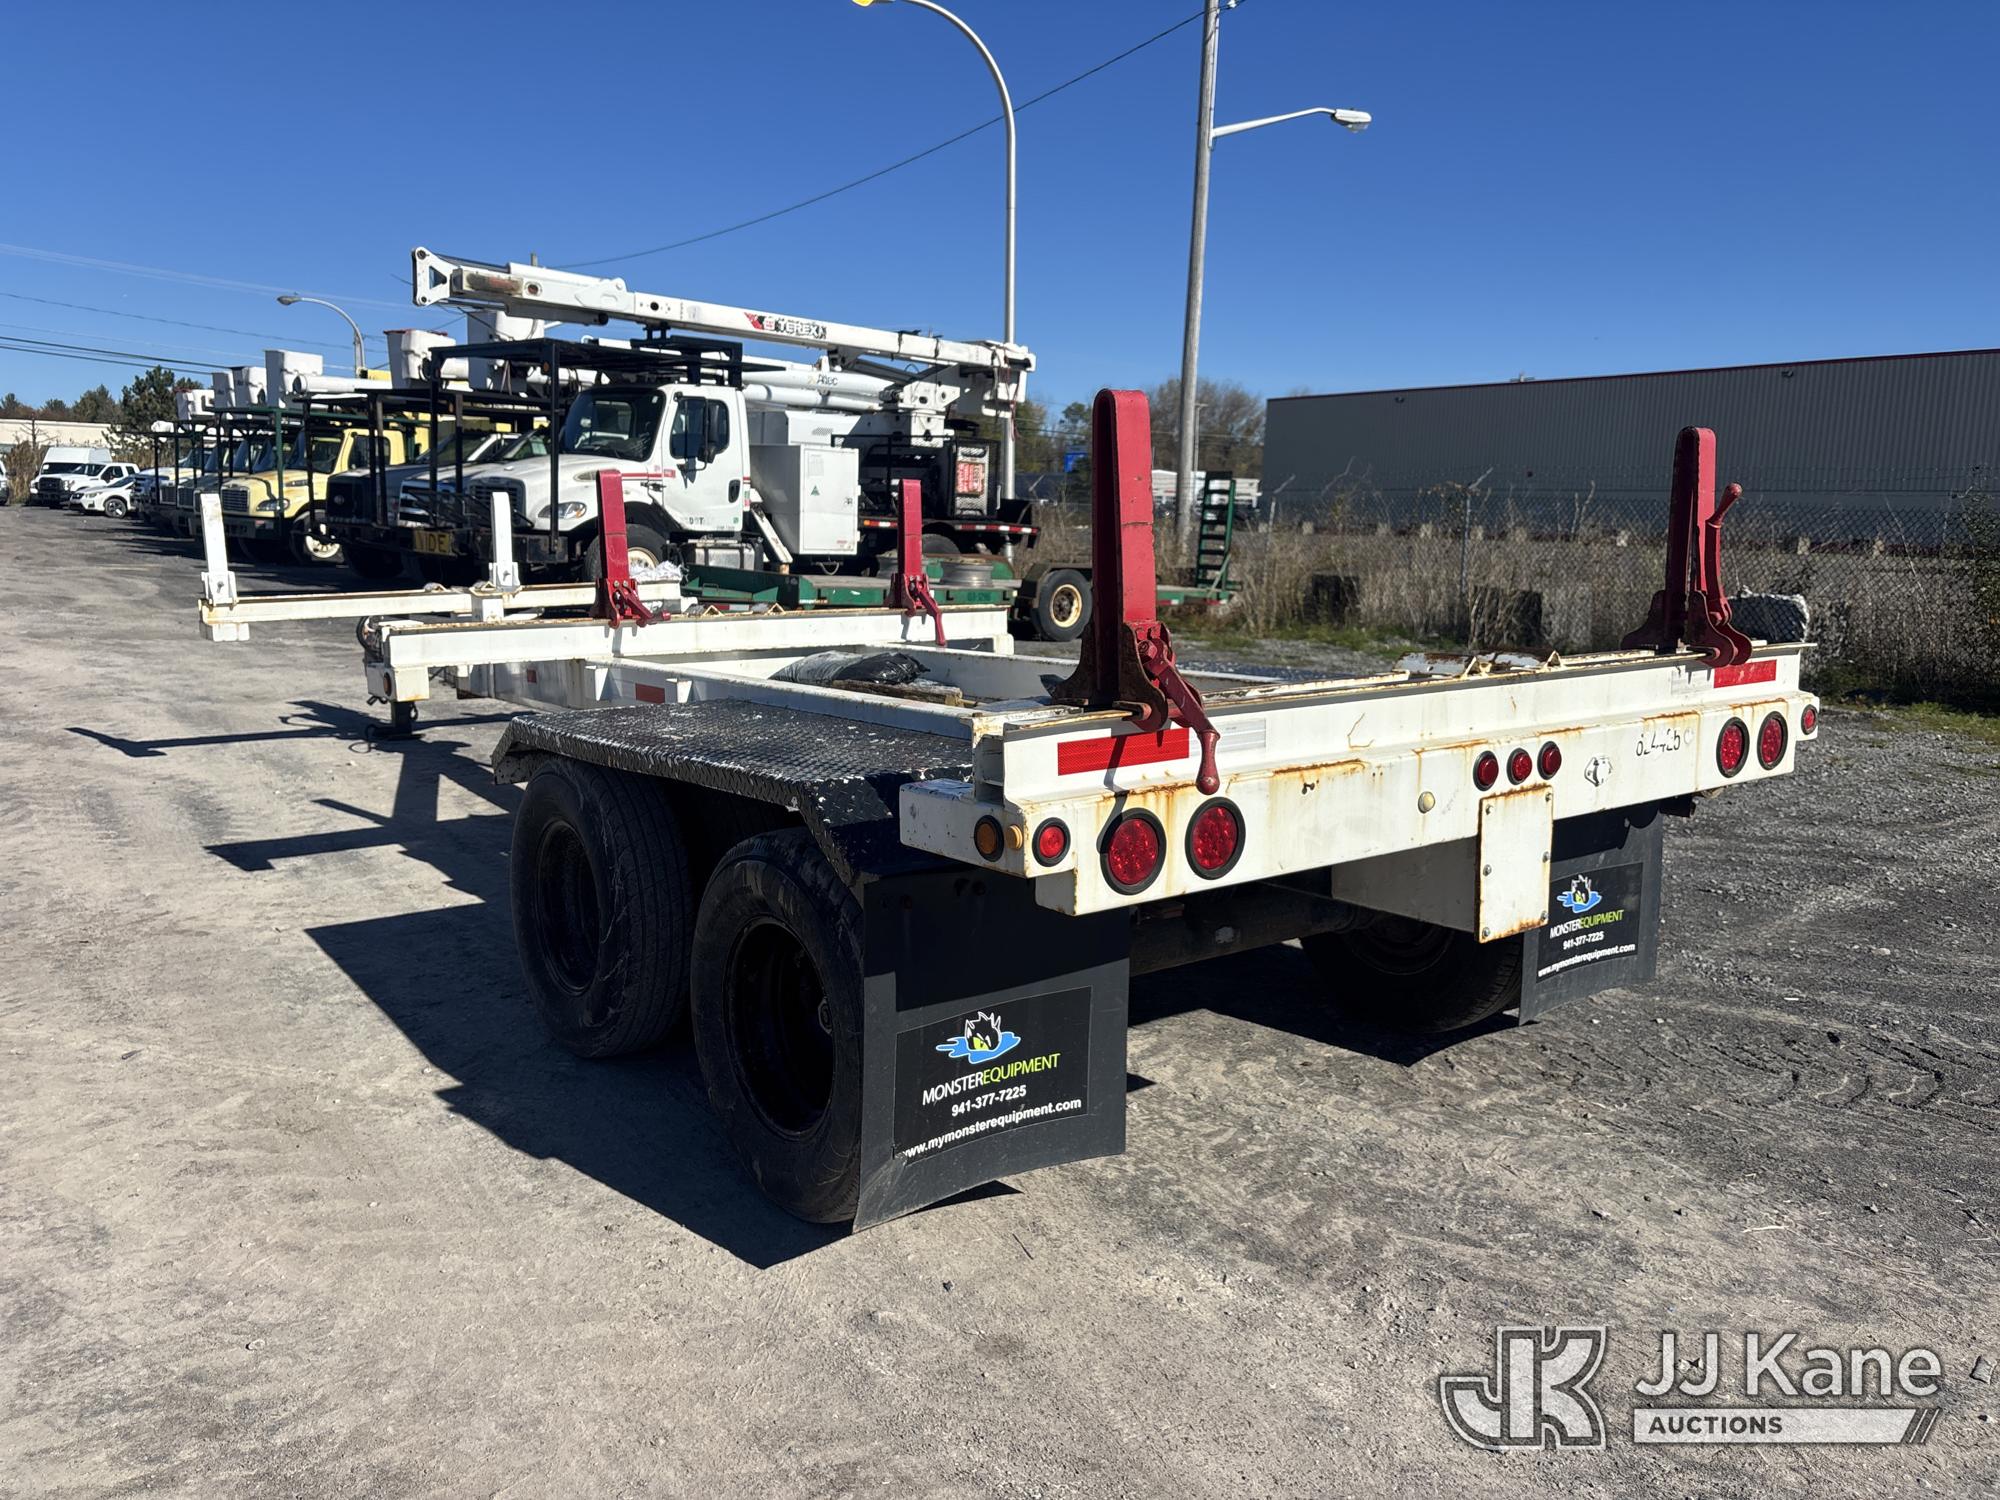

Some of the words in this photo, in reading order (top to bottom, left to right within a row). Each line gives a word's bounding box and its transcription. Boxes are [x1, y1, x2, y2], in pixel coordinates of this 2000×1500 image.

[1549, 909, 1625, 940] MONSTEREQUIPMENT
[1562, 930, 1605, 951] 941-377-7225
[1537, 943, 1636, 978] www.mymonsterequipment.com
[922, 1052, 1061, 1106] MONSTEREQUIPMENT
[951, 1084, 1027, 1117] 941-377-7225
